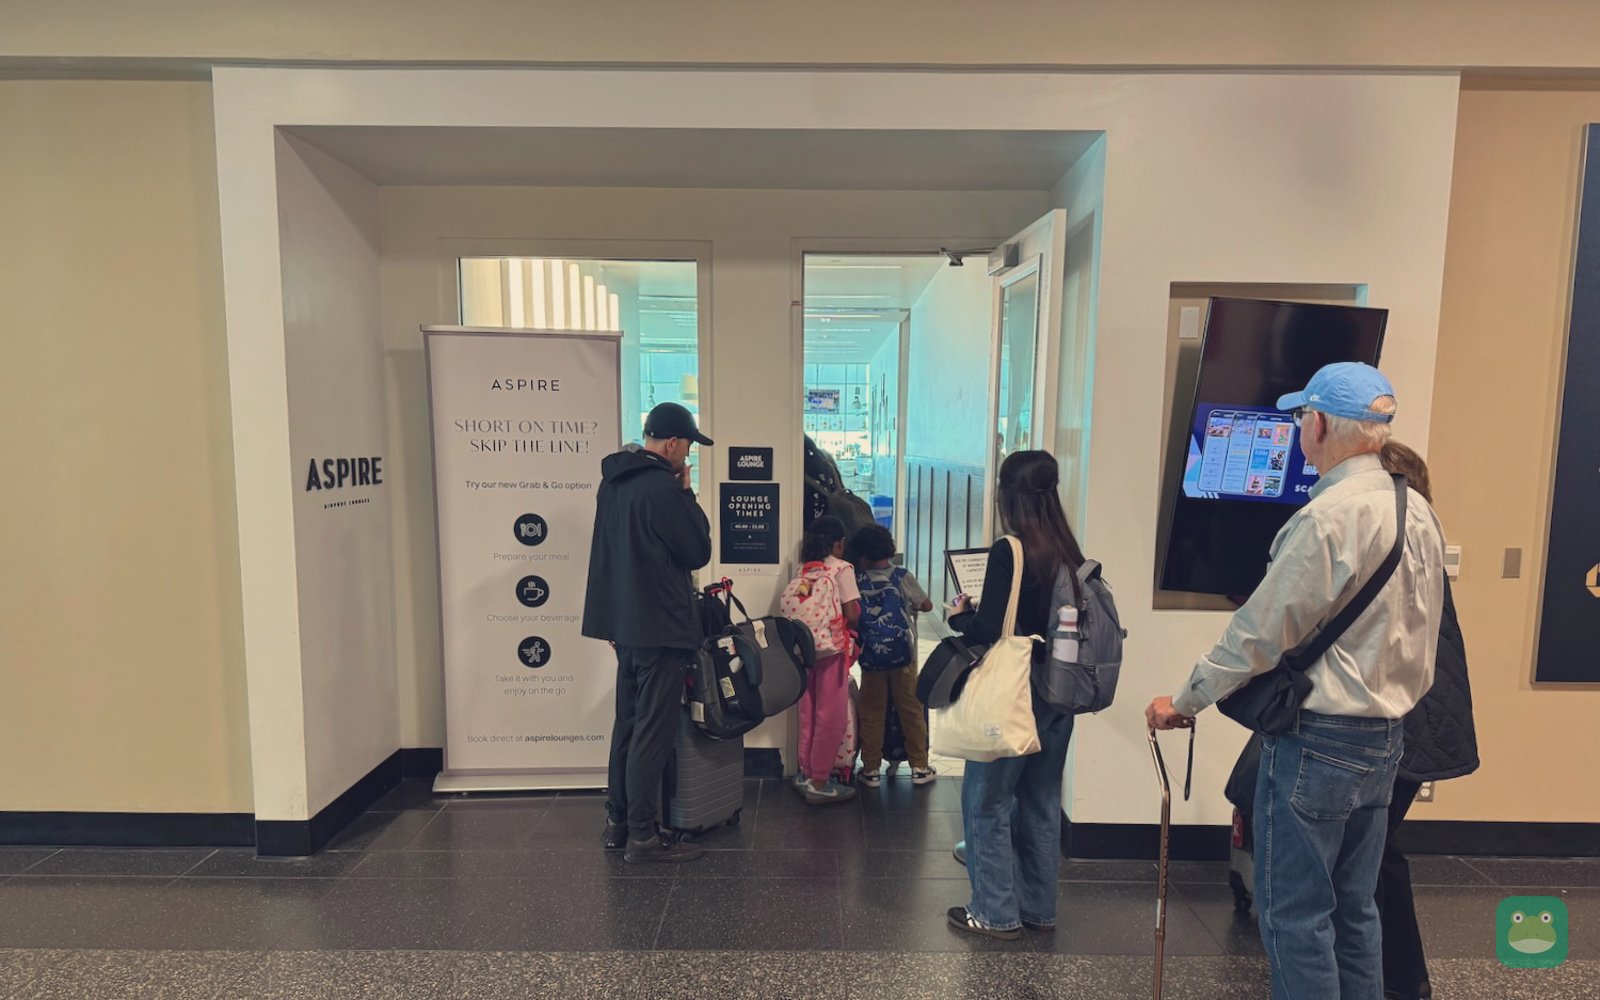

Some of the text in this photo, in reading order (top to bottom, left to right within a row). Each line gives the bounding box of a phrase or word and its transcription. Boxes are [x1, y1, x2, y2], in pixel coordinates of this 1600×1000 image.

[491, 379, 560, 391] ASPIRE
[454, 419, 598, 435] SHORT ON TIME?
[470, 439, 590, 454] SKIP THE LINE!
[306, 457, 383, 491] ASPIRE
[465, 480, 479, 490] Try
[519, 480, 541, 489] Grab
[542, 481, 549, 489] &
[551, 481, 563, 489] Go
[564, 481, 592, 491] option
[493, 553, 569, 562] Prepare your meal
[486, 613, 580, 624] Choose your beverage
[495, 674, 574, 684] Take it with you and
[504, 686, 527, 696] enjoy
[540, 686, 554, 694] the
[556, 688, 566, 696] go
[467, 734, 488, 743] Book
[490, 734, 514, 743] direct
[524, 734, 605, 744] aspirelounges.com
